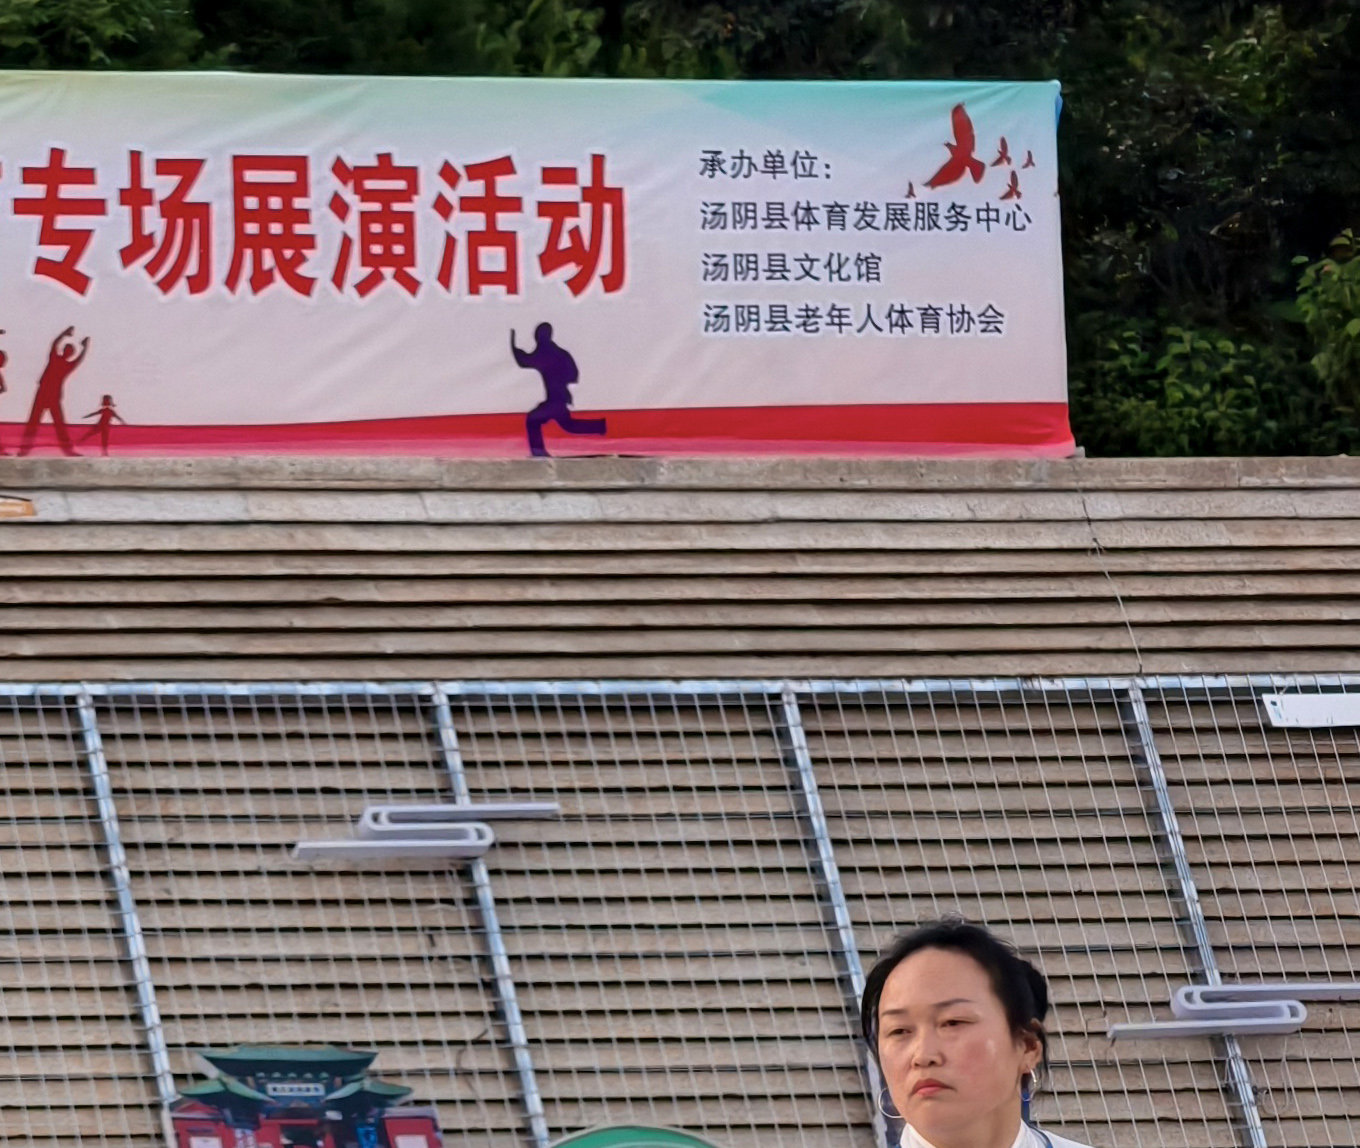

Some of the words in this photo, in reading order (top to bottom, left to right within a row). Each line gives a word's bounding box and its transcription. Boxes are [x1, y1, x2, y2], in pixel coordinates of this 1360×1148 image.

[700, 202, 1032, 232] 汤阴县体育发展服务中心
[702, 252, 882, 282] 汤阴县文化馆
[703, 303, 1005, 334] 汤阴县老年人体育协会
